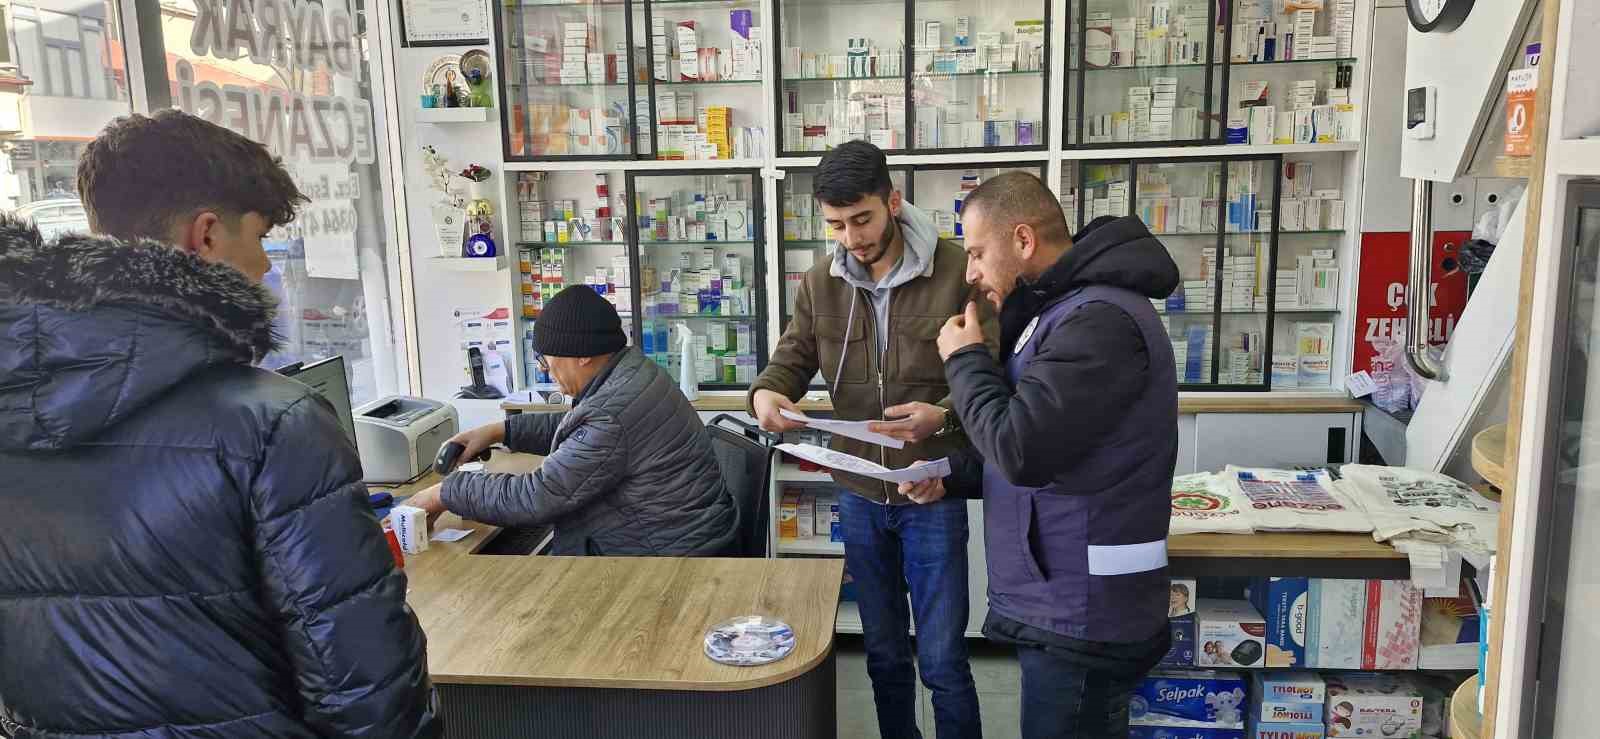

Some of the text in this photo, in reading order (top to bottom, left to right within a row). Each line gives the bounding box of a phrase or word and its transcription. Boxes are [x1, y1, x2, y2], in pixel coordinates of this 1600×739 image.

[1387, 282, 1440, 311] ÇK
[1365, 313, 1455, 343] ZEHLİ
[1156, 684, 1205, 703] Selpak
